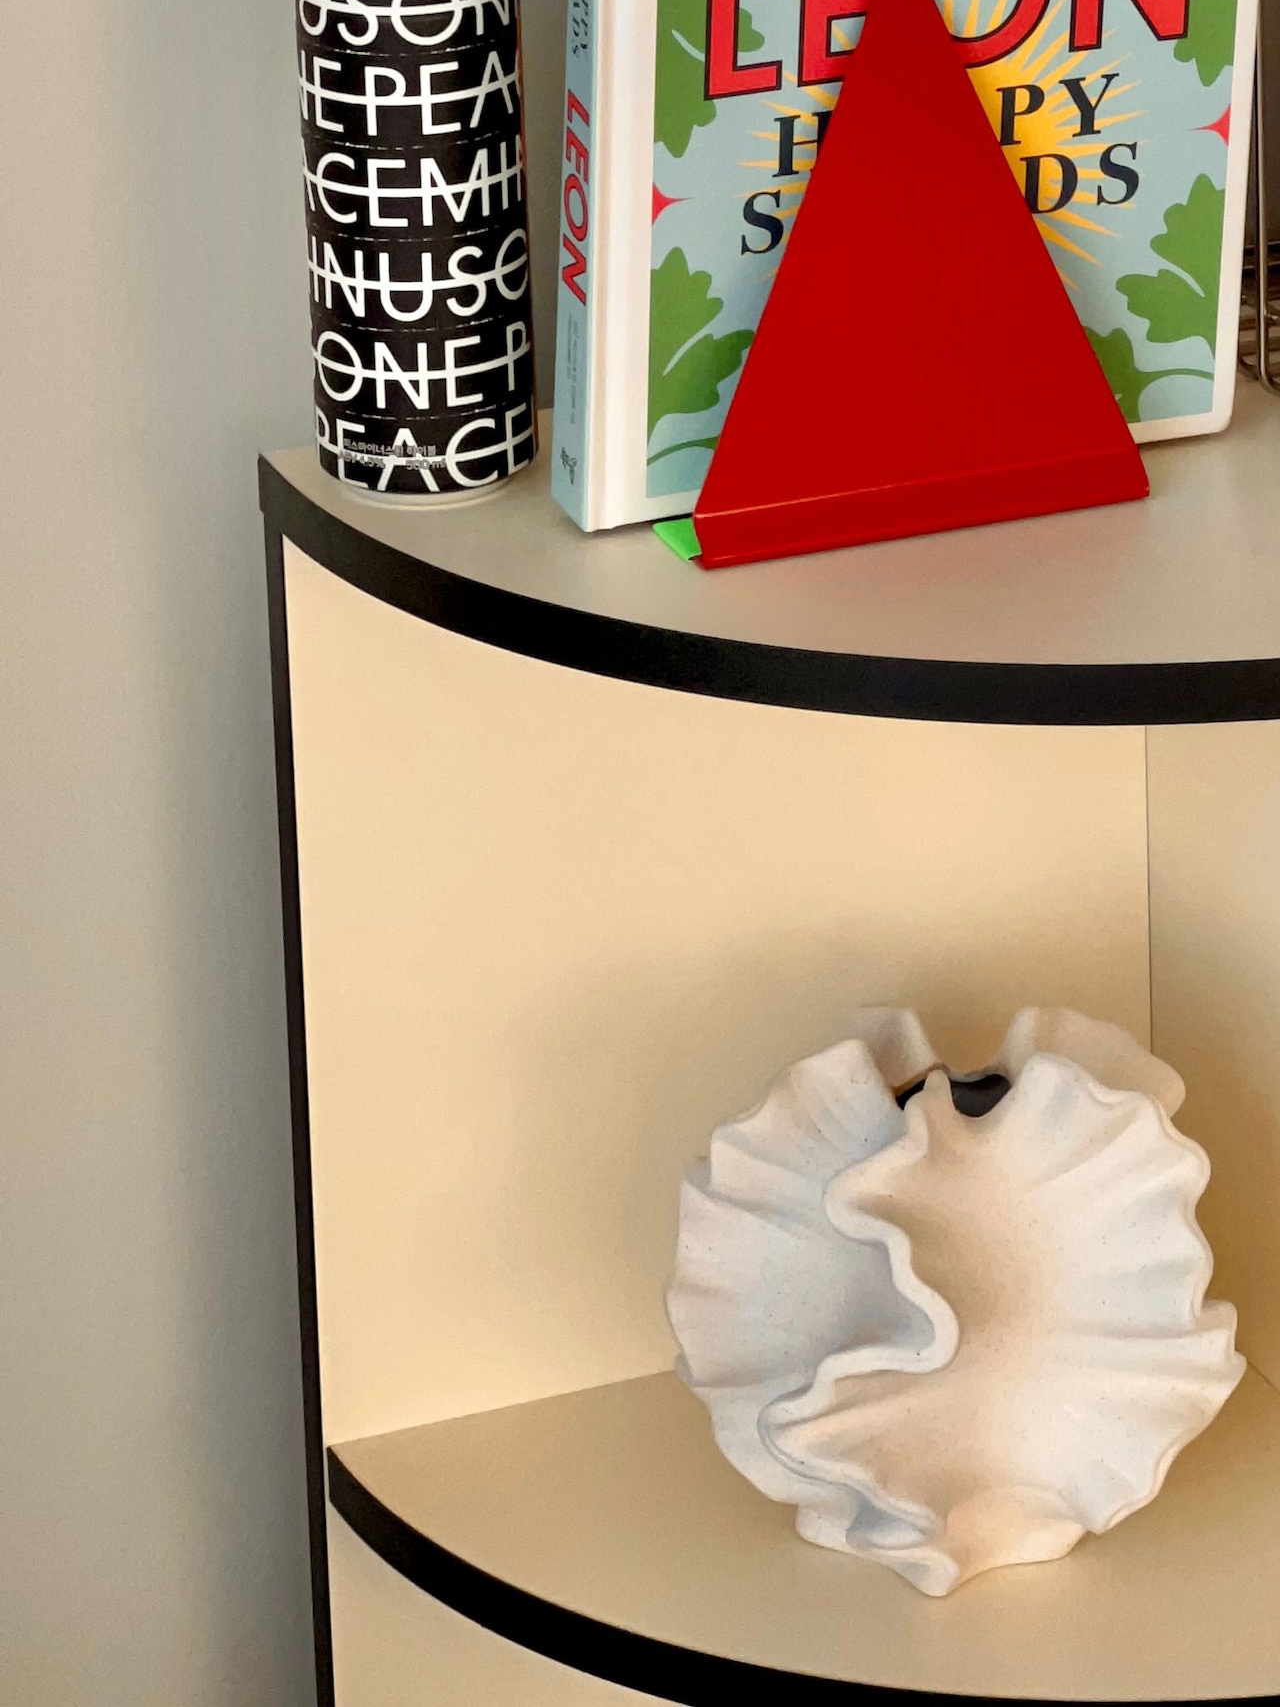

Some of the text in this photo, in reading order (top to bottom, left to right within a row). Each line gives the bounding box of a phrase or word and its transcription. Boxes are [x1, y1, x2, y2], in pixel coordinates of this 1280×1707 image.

[772, 74, 1119, 178] HPY
[562, 88, 590, 306] LEON
[741, 142, 1139, 256] SDS
[315, 402, 533, 492] PEACE
